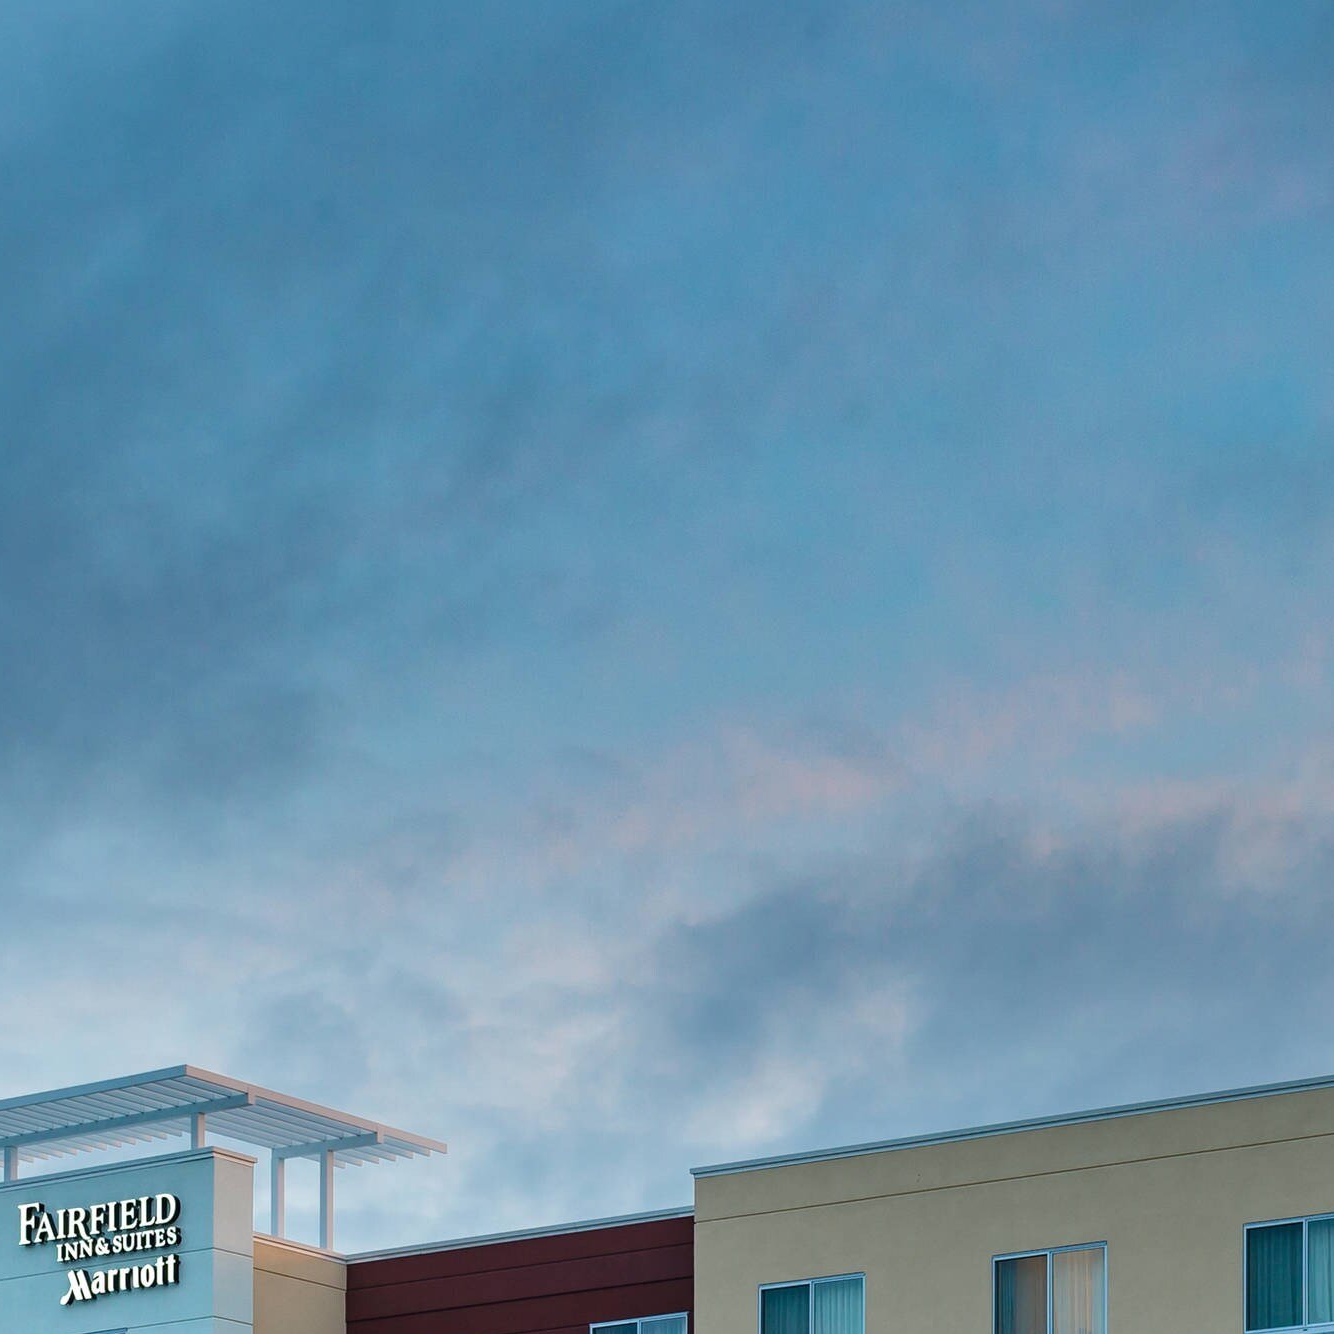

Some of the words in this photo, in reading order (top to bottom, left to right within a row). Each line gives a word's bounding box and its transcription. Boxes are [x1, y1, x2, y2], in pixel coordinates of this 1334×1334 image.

[18, 1193, 178, 1246] FAIRFIELD
[56, 1238, 94, 1262] INN
[112, 1226, 178, 1254] SUITES
[60, 1254, 178, 1305] Marriott
